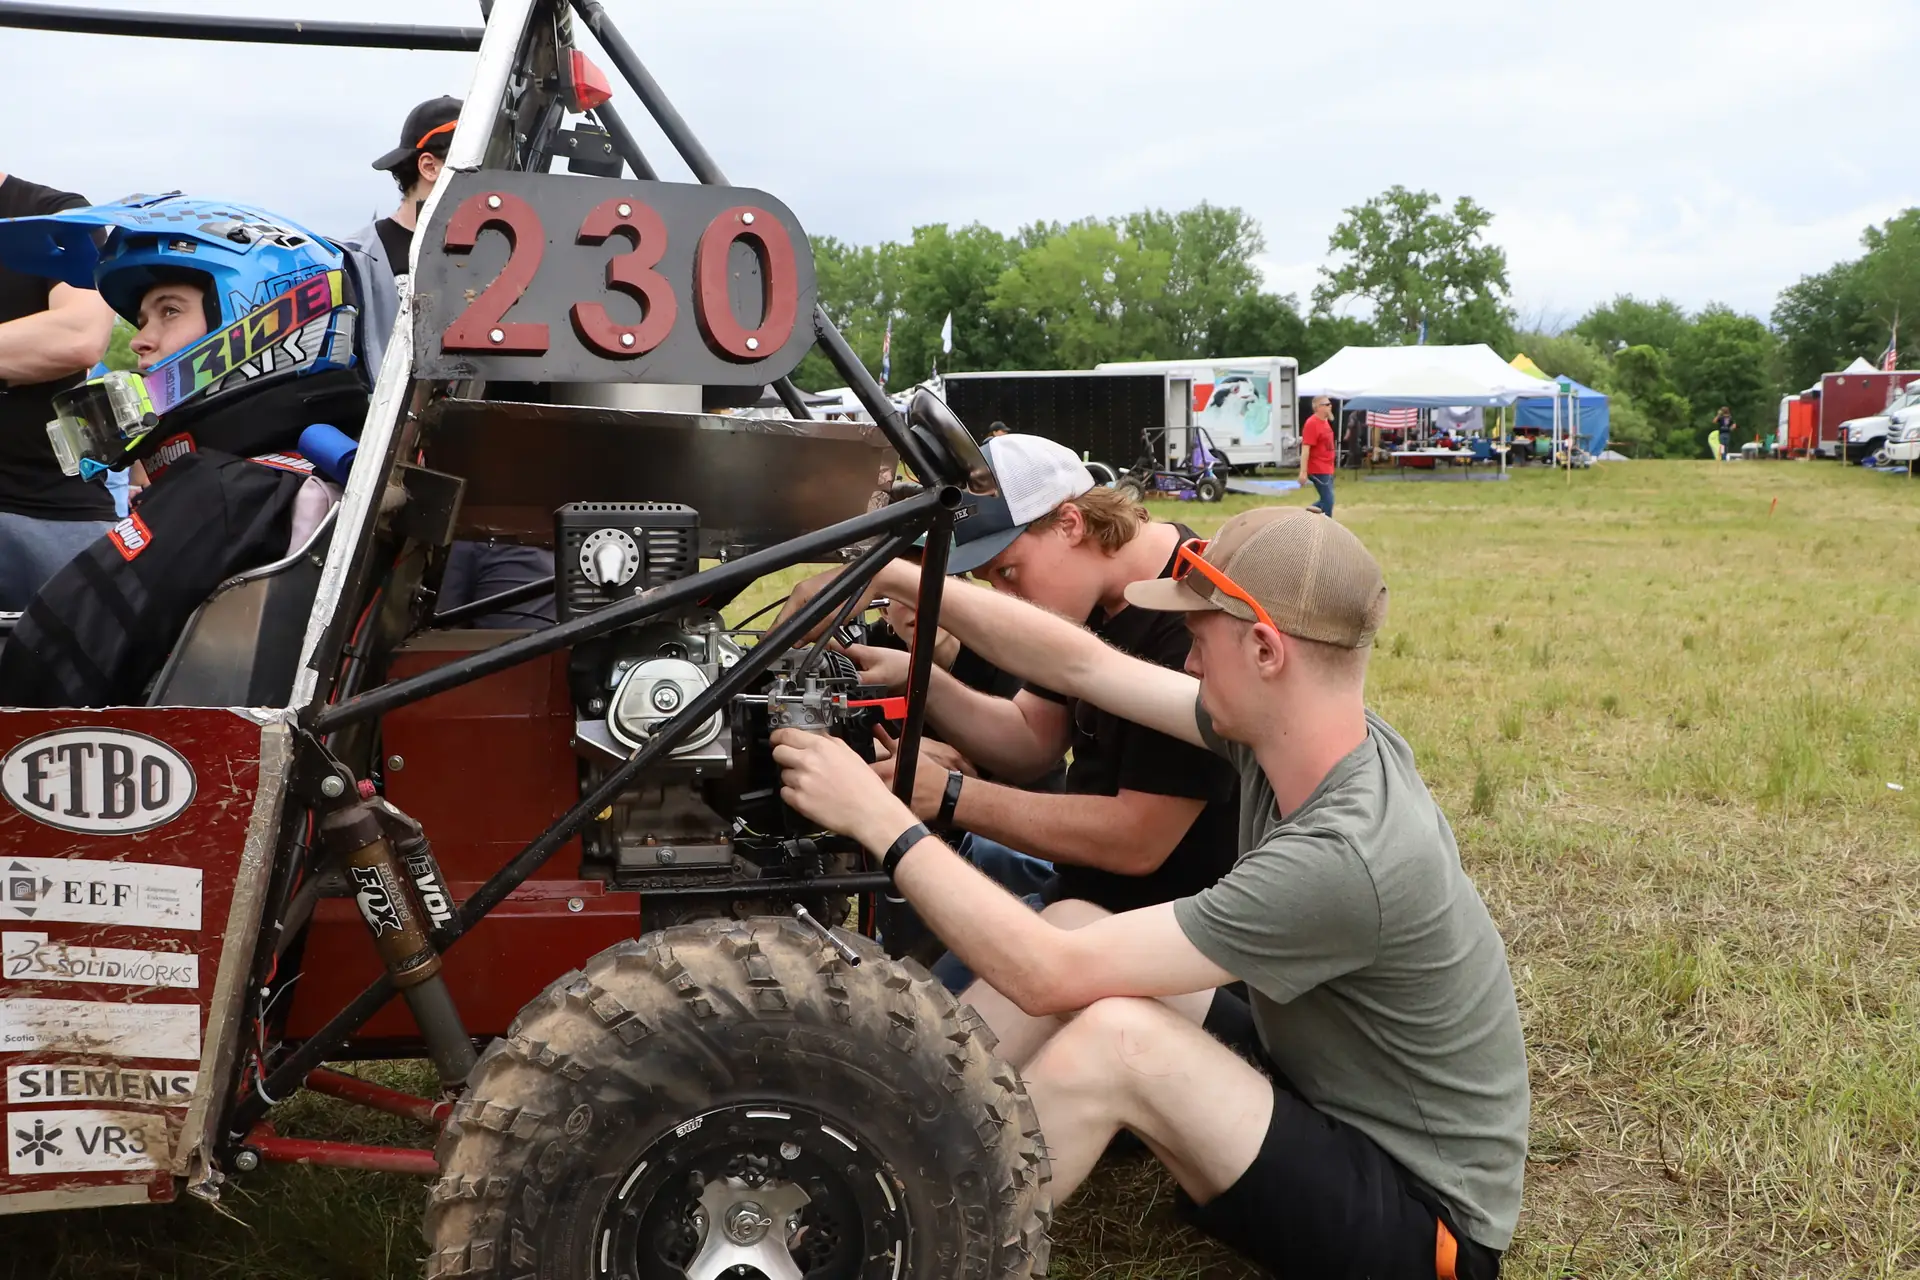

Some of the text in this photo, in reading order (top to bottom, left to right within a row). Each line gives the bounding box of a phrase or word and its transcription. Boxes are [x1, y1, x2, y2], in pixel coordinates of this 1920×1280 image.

[441, 191, 799, 364] 230
[177, 277, 328, 398] RIDE
[953, 508, 969, 521] TEK
[21, 742, 174, 819] ETBO
[64, 880, 131, 907] EEF
[351, 866, 403, 933] FOX
[406, 855, 452, 929] EVOL
[58, 958, 192, 983] SOLIDWORKS
[5, 1034, 35, 1043] Scotia
[19, 1070, 190, 1099] SIEMENS
[76, 1126, 148, 1155] VR3
